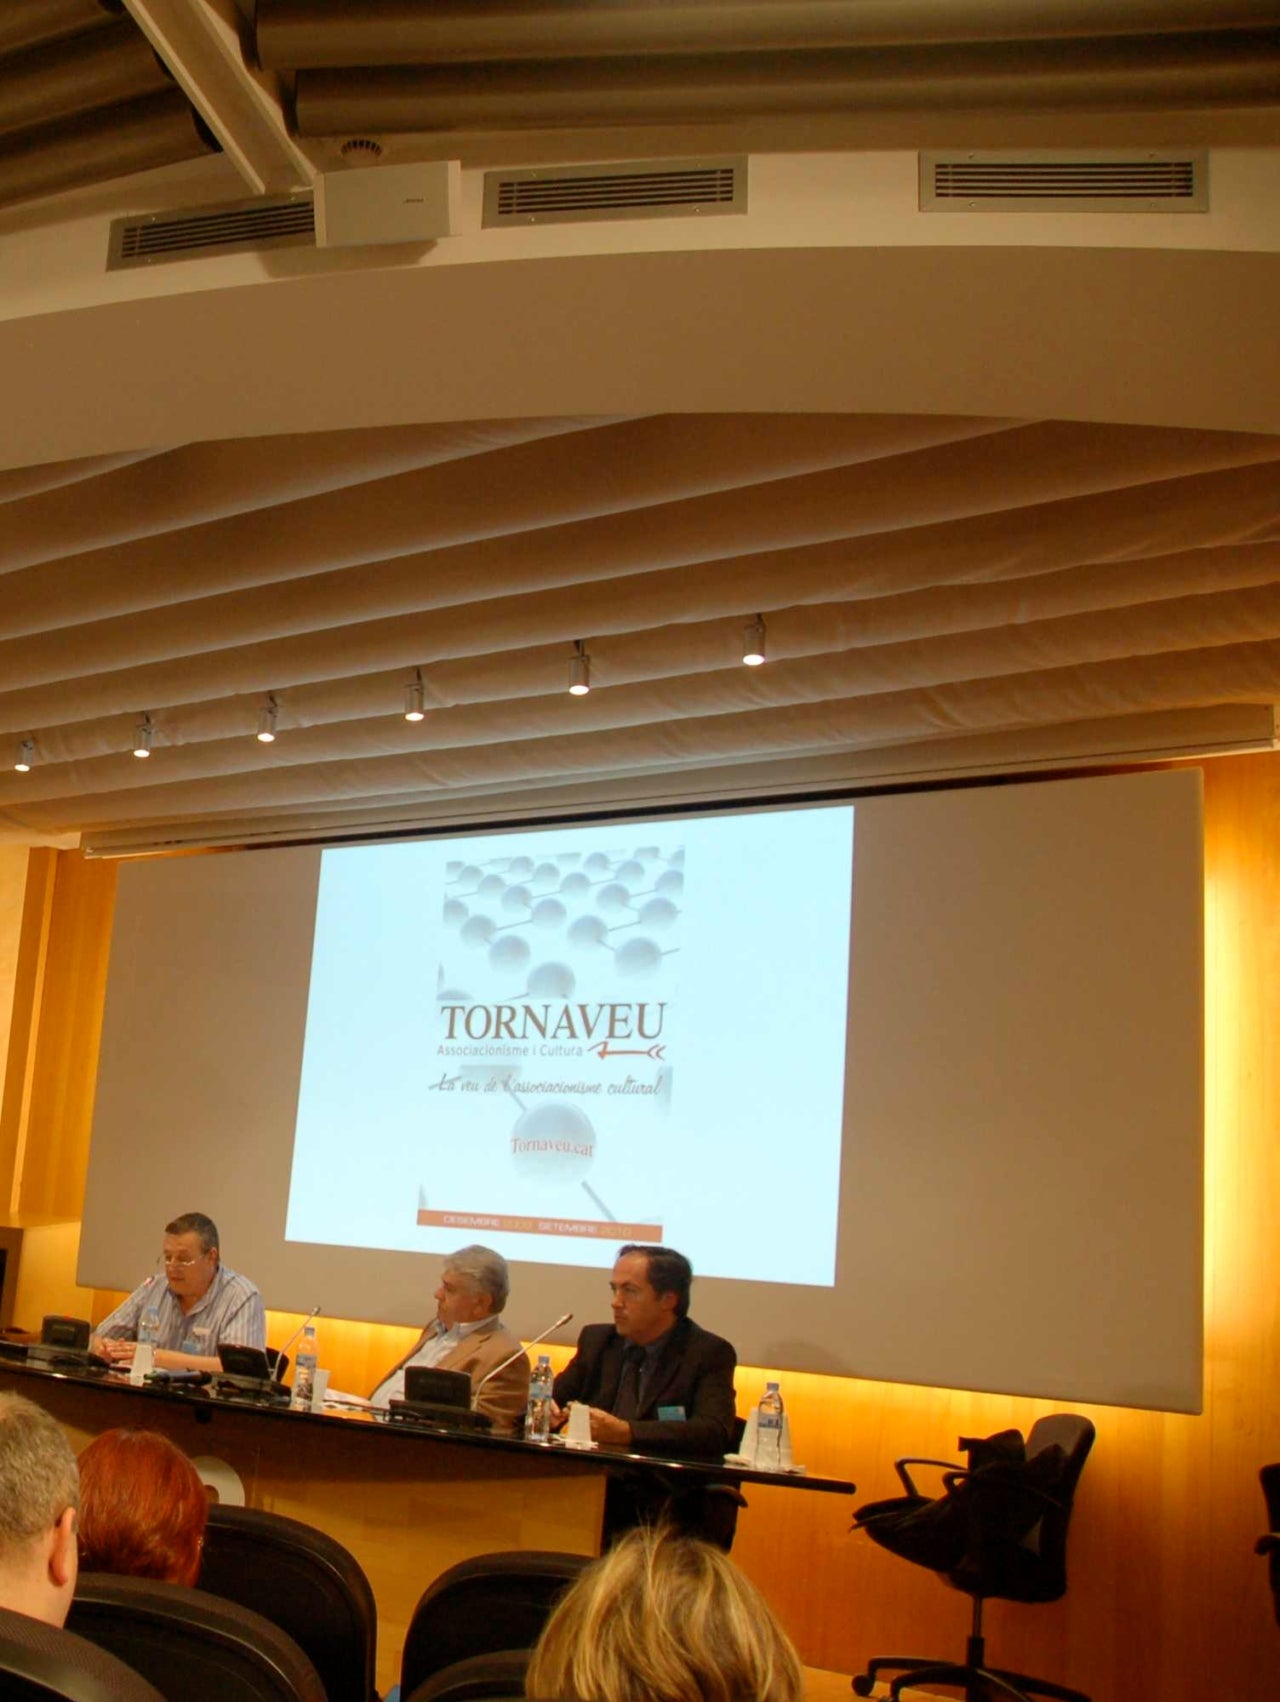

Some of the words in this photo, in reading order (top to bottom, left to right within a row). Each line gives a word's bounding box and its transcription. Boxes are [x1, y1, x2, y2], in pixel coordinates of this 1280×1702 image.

[440, 1002, 668, 1041] TORNAVEU
[437, 1044, 530, 1058] Associacionisme
[539, 1043, 584, 1057] Cultura
[460, 1080, 479, 1092] veu
[484, 1076, 498, 1093] de
[607, 1075, 663, 1095] cultural
[510, 1137, 595, 1158] Tornaveu.cat
